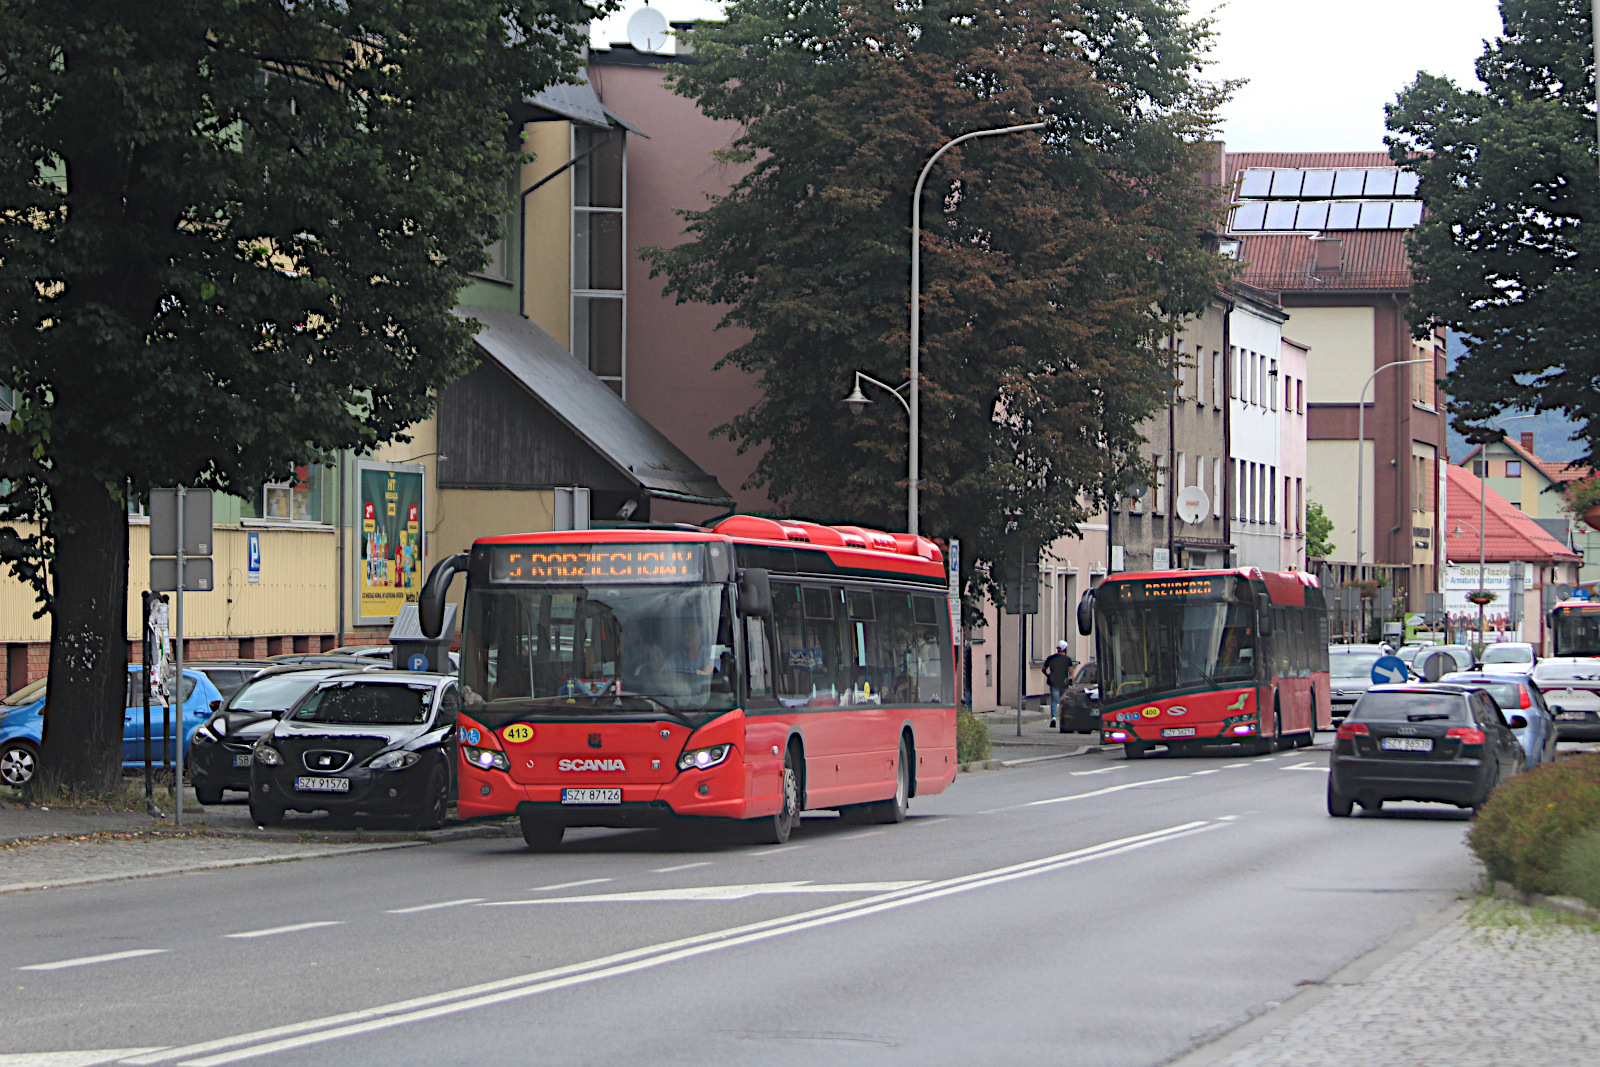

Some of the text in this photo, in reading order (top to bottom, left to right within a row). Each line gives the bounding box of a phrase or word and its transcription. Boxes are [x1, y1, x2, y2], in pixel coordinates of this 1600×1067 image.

[509, 551, 692, 576] 5 RADZIECHOWY
[413, 658, 423, 670] P
[508, 728, 528, 739] 413
[1386, 738, 1401, 747] SZY
[558, 758, 626, 772] SCANIA
[300, 778, 348, 789] SZY 91576
[567, 790, 620, 800] SZY 87126
